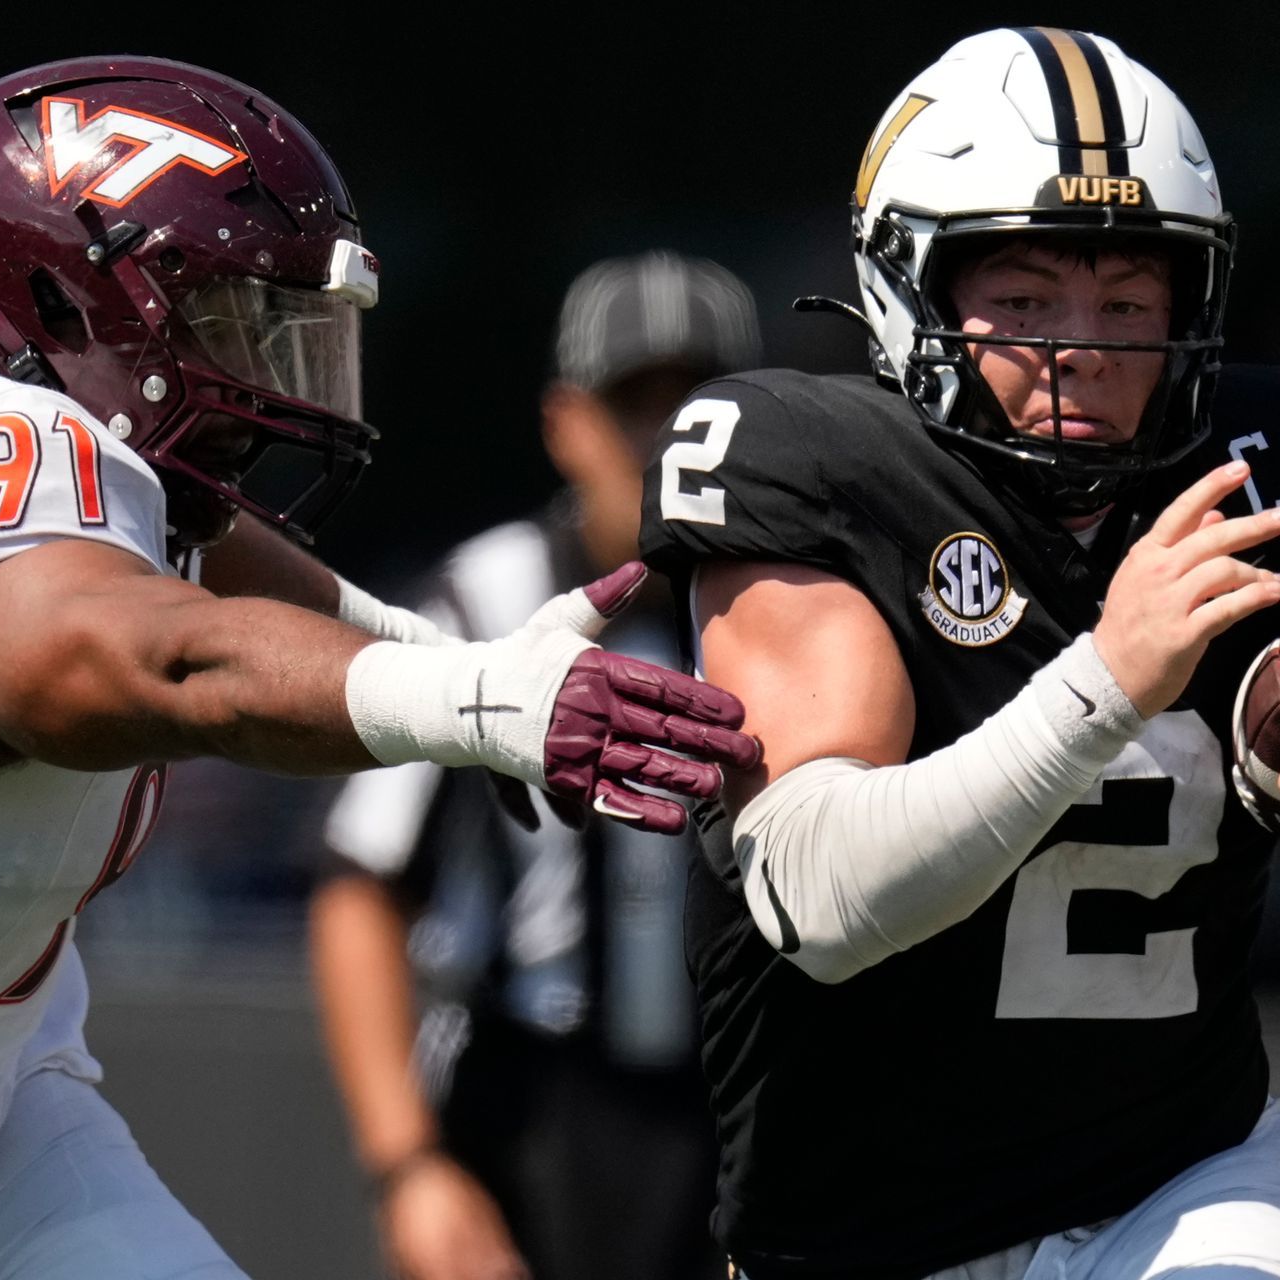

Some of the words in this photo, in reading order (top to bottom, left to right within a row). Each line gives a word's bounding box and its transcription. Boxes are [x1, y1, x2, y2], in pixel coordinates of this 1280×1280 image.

[41, 96, 249, 208] VT
[1057, 176, 1144, 206] VUFB
[660, 398, 741, 526] 2
[936, 538, 1003, 617] SEC
[931, 609, 1014, 642] GRADUATE
[995, 709, 1226, 1019] 2
